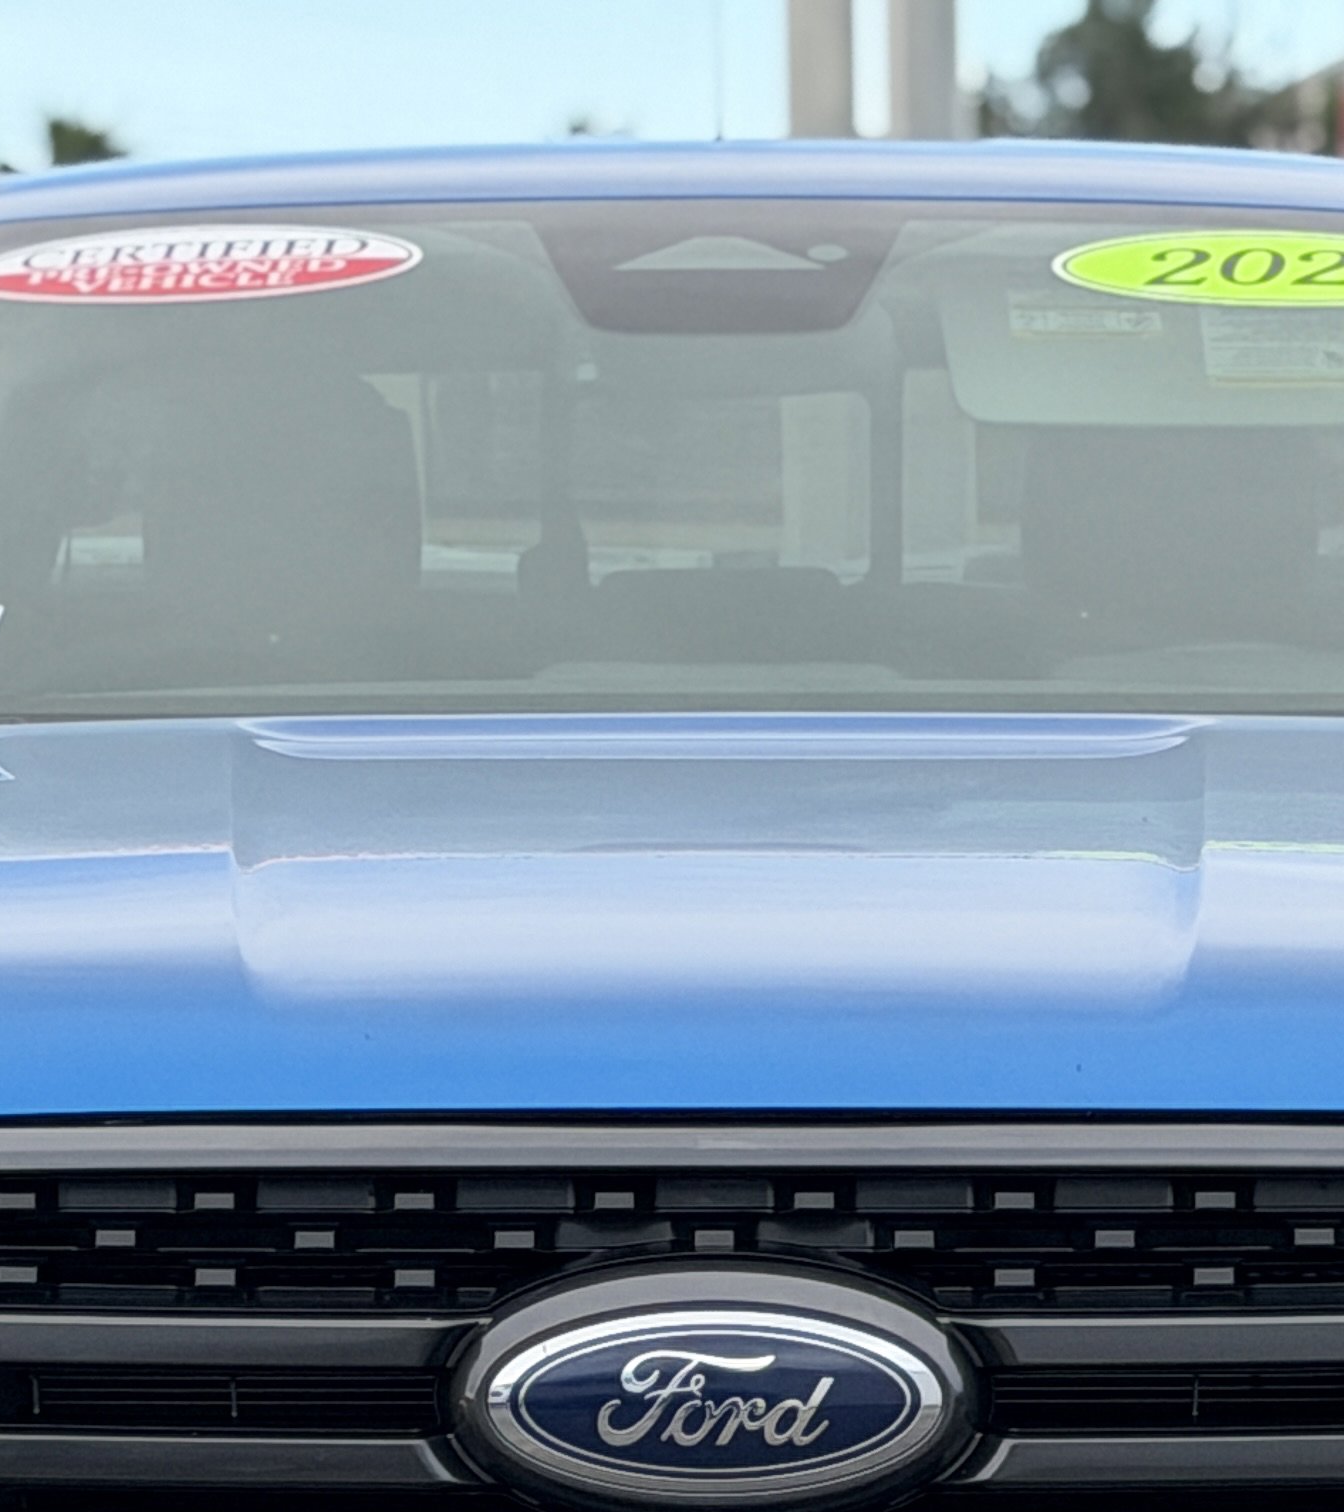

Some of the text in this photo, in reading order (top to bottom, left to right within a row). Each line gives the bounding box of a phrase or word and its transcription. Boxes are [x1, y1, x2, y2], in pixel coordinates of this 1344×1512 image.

[22, 237, 369, 275] CERTIFIED
[72, 270, 296, 293] VEHICLE
[596, 1348, 835, 1447] Ford
